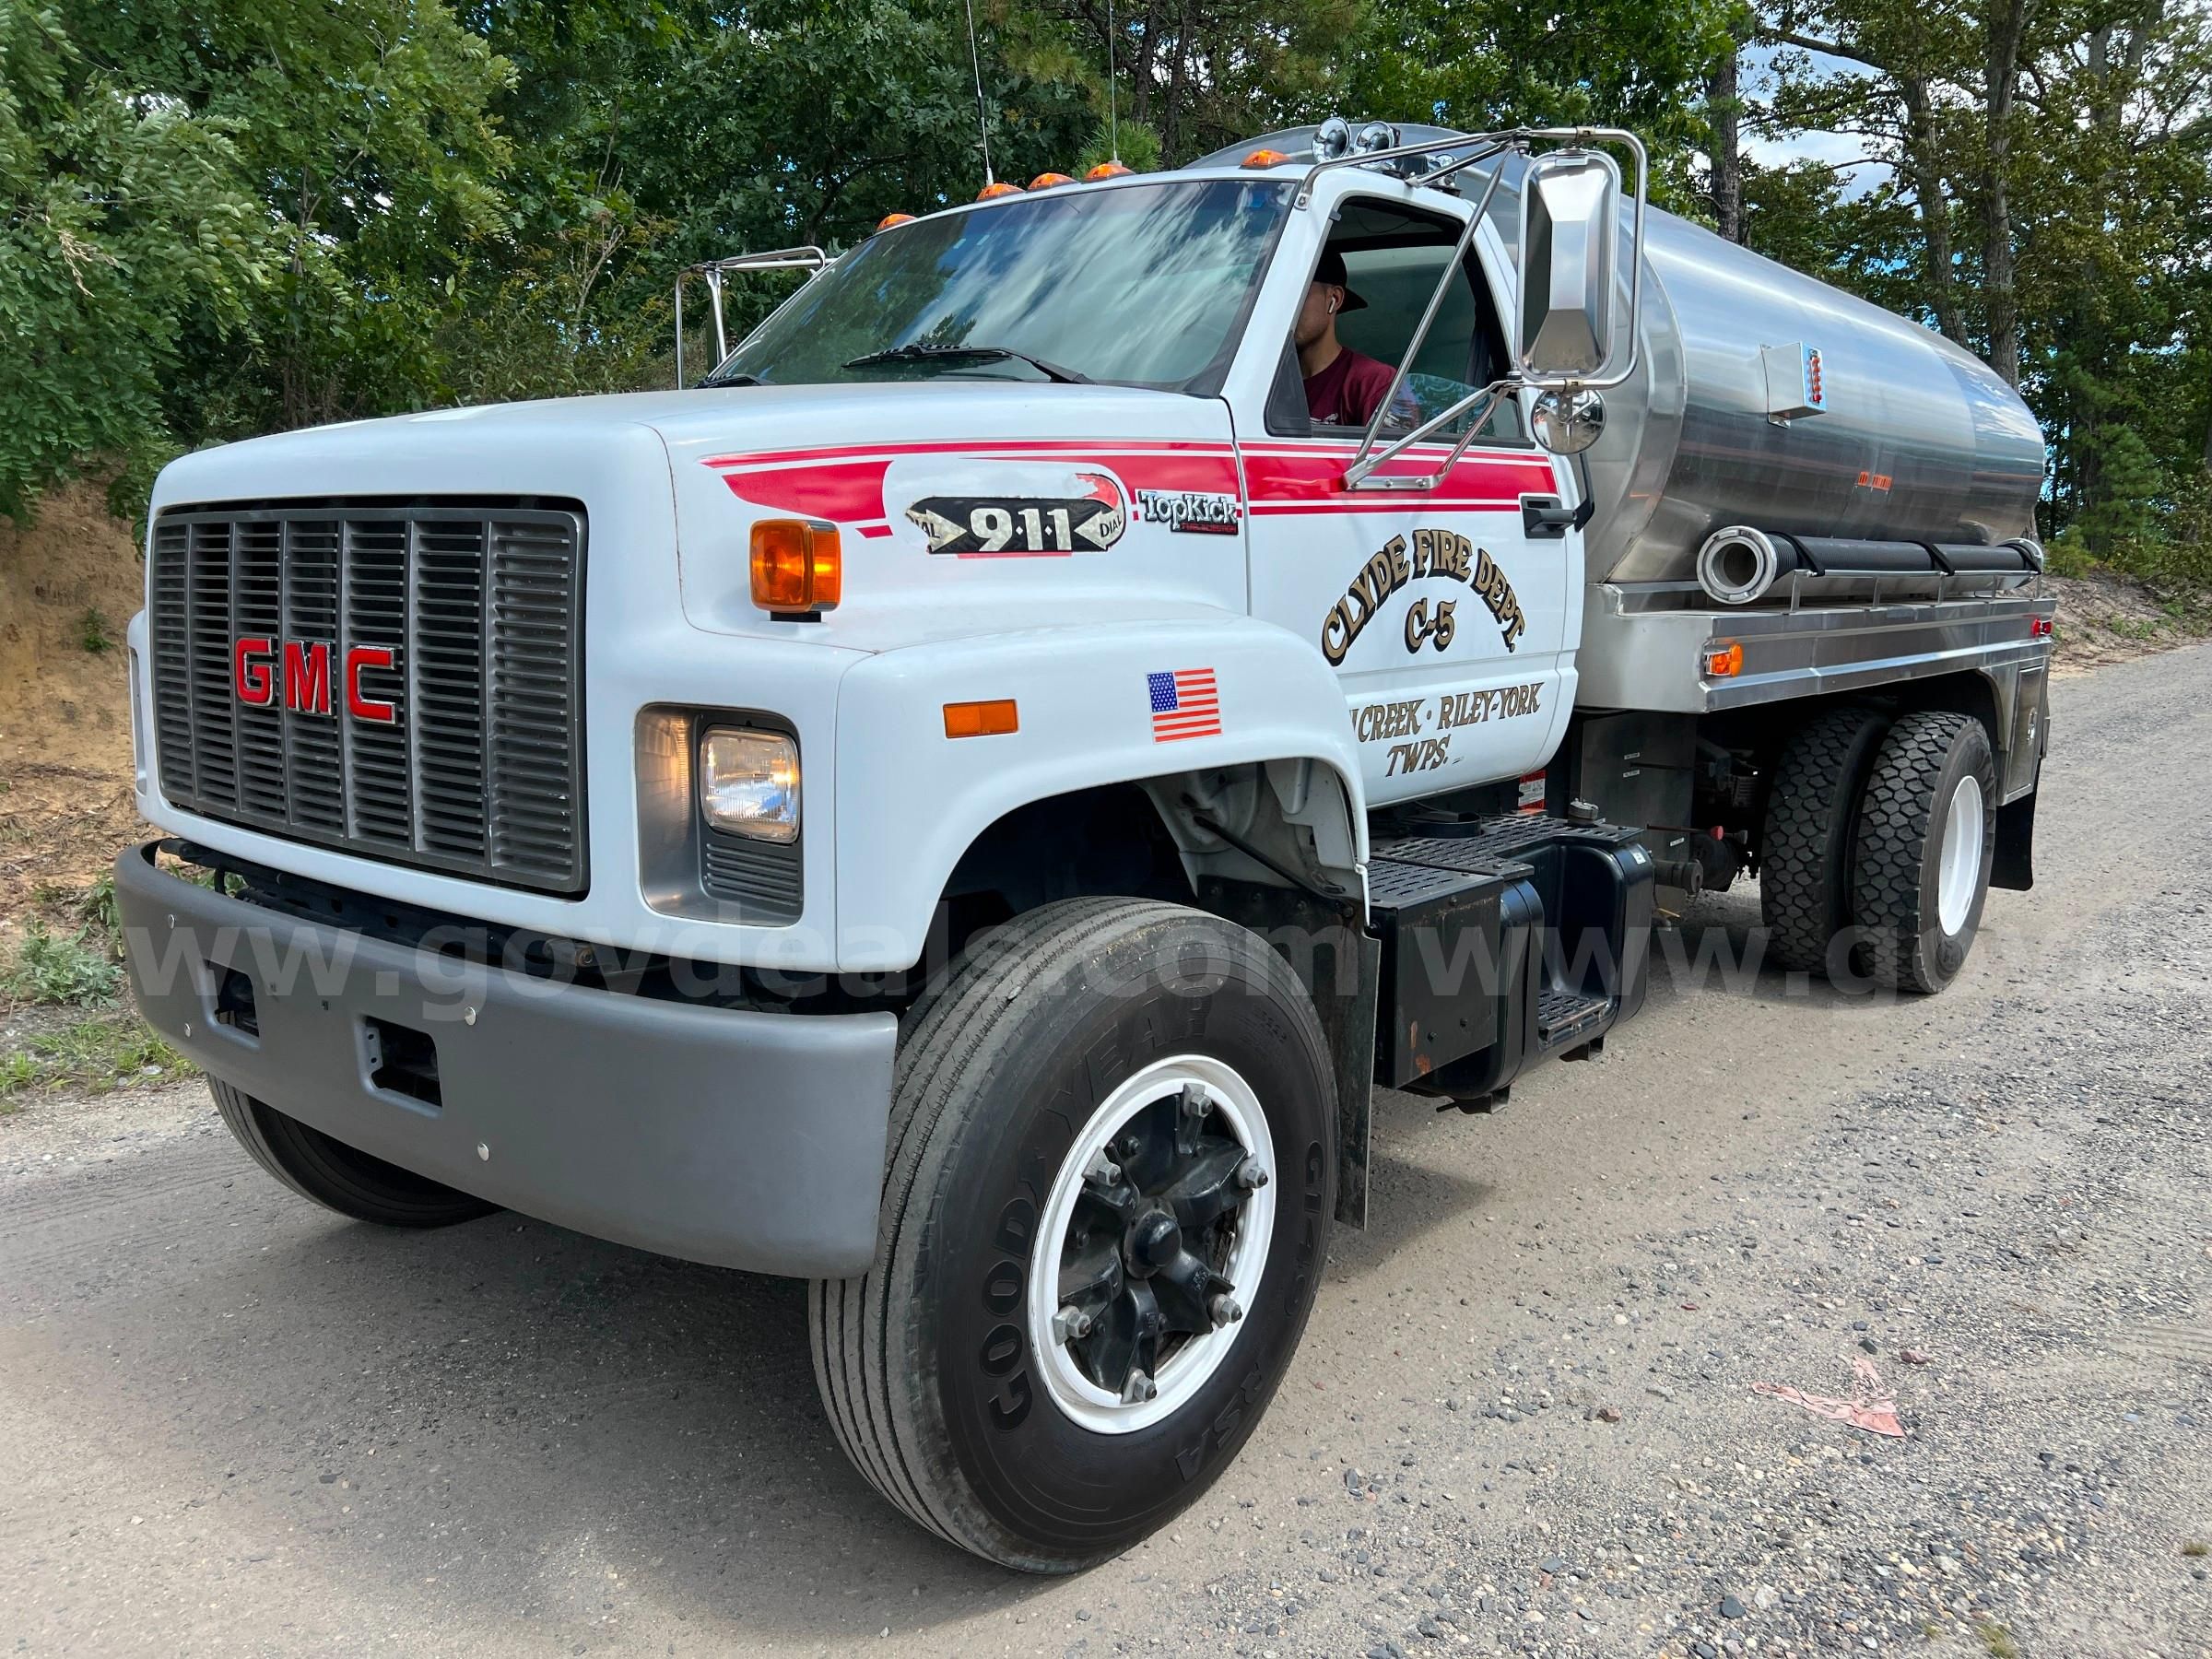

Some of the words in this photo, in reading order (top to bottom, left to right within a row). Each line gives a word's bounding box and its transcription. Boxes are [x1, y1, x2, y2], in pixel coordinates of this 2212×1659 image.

[1100, 515, 1123, 538] DIAL
[1322, 534, 1411, 667] CLYDE
[1412, 529, 1474, 582] FIRE
[1404, 597, 1457, 654] C-5
[236, 637, 396, 725] GMC
